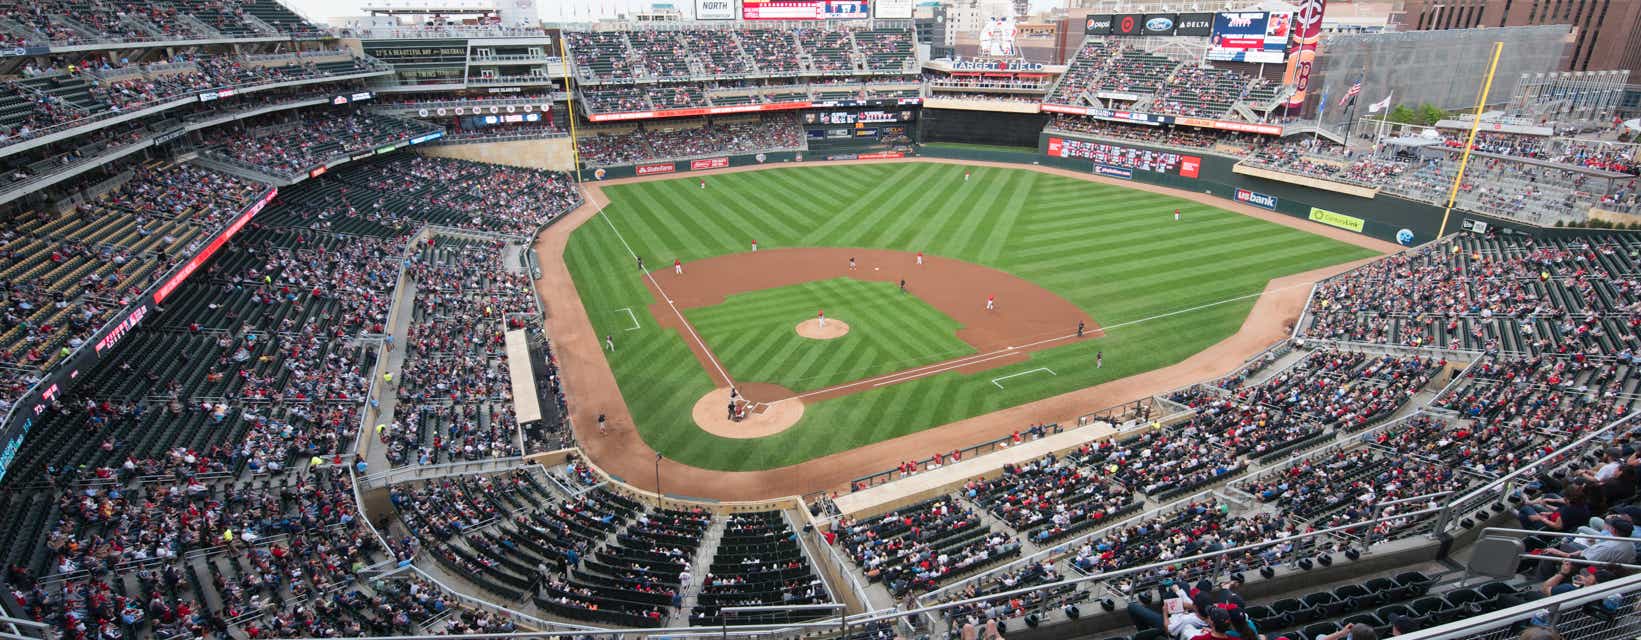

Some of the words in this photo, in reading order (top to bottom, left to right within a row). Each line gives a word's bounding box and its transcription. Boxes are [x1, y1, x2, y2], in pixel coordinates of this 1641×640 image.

[702, 2, 728, 10] NORTH
[953, 62, 999, 71] TARGET
[1009, 62, 1043, 71] FIELD
[1250, 191, 1275, 208] bank
